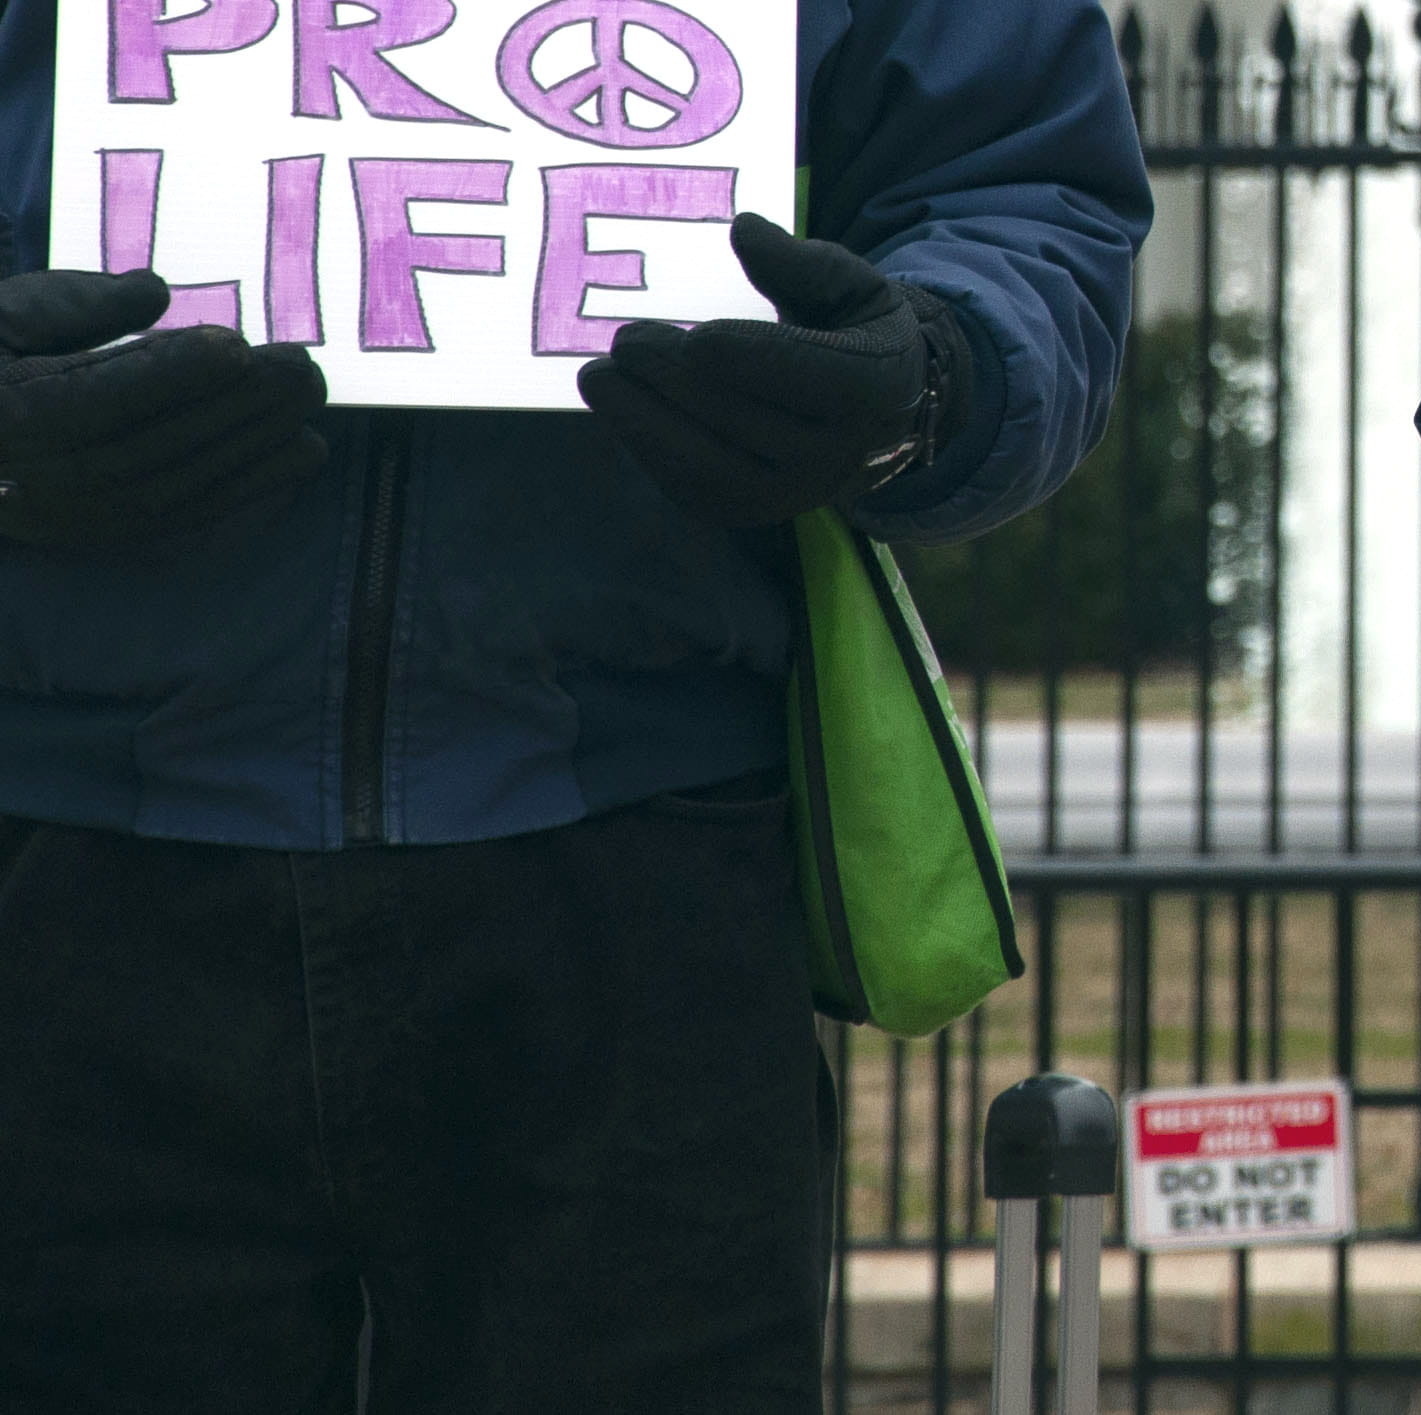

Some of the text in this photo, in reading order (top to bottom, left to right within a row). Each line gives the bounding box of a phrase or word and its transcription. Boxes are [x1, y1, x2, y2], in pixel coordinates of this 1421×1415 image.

[94, 146, 740, 358] LIFE
[1159, 1155, 1320, 1195] DO NOT
[1169, 1195, 1312, 1229] ENTER
